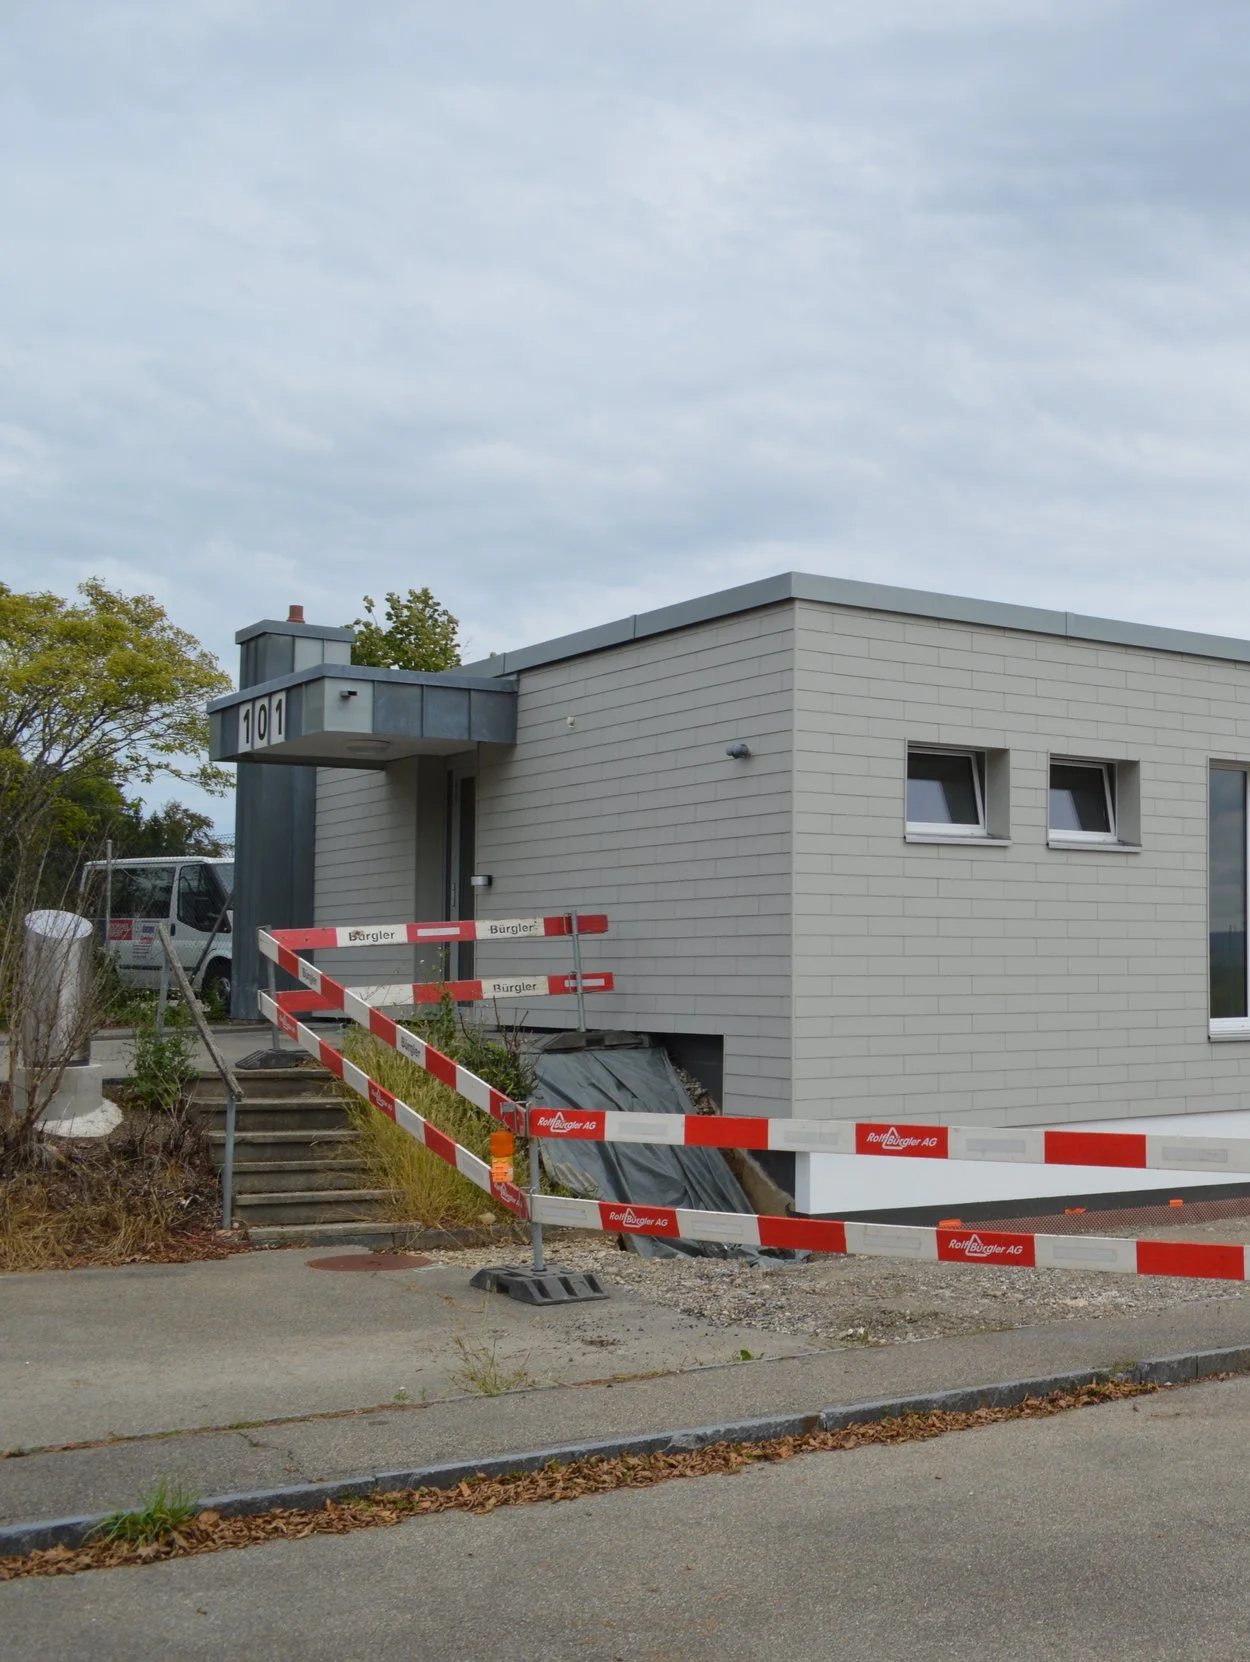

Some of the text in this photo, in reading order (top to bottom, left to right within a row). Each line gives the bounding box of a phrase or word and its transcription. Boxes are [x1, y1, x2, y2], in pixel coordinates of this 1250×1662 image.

[242, 698, 283, 744] 101
[490, 923, 535, 935] Bürgler
[493, 982, 537, 994] Bürgler
[537, 1116, 597, 1132] Rolf Bürgler AG
[866, 1132, 938, 1148] Rolf Bürgler AG
[609, 1211, 669, 1227] Rolf Bürgler AG
[948, 1239, 1023, 1255] Rolf Bürgler AG
